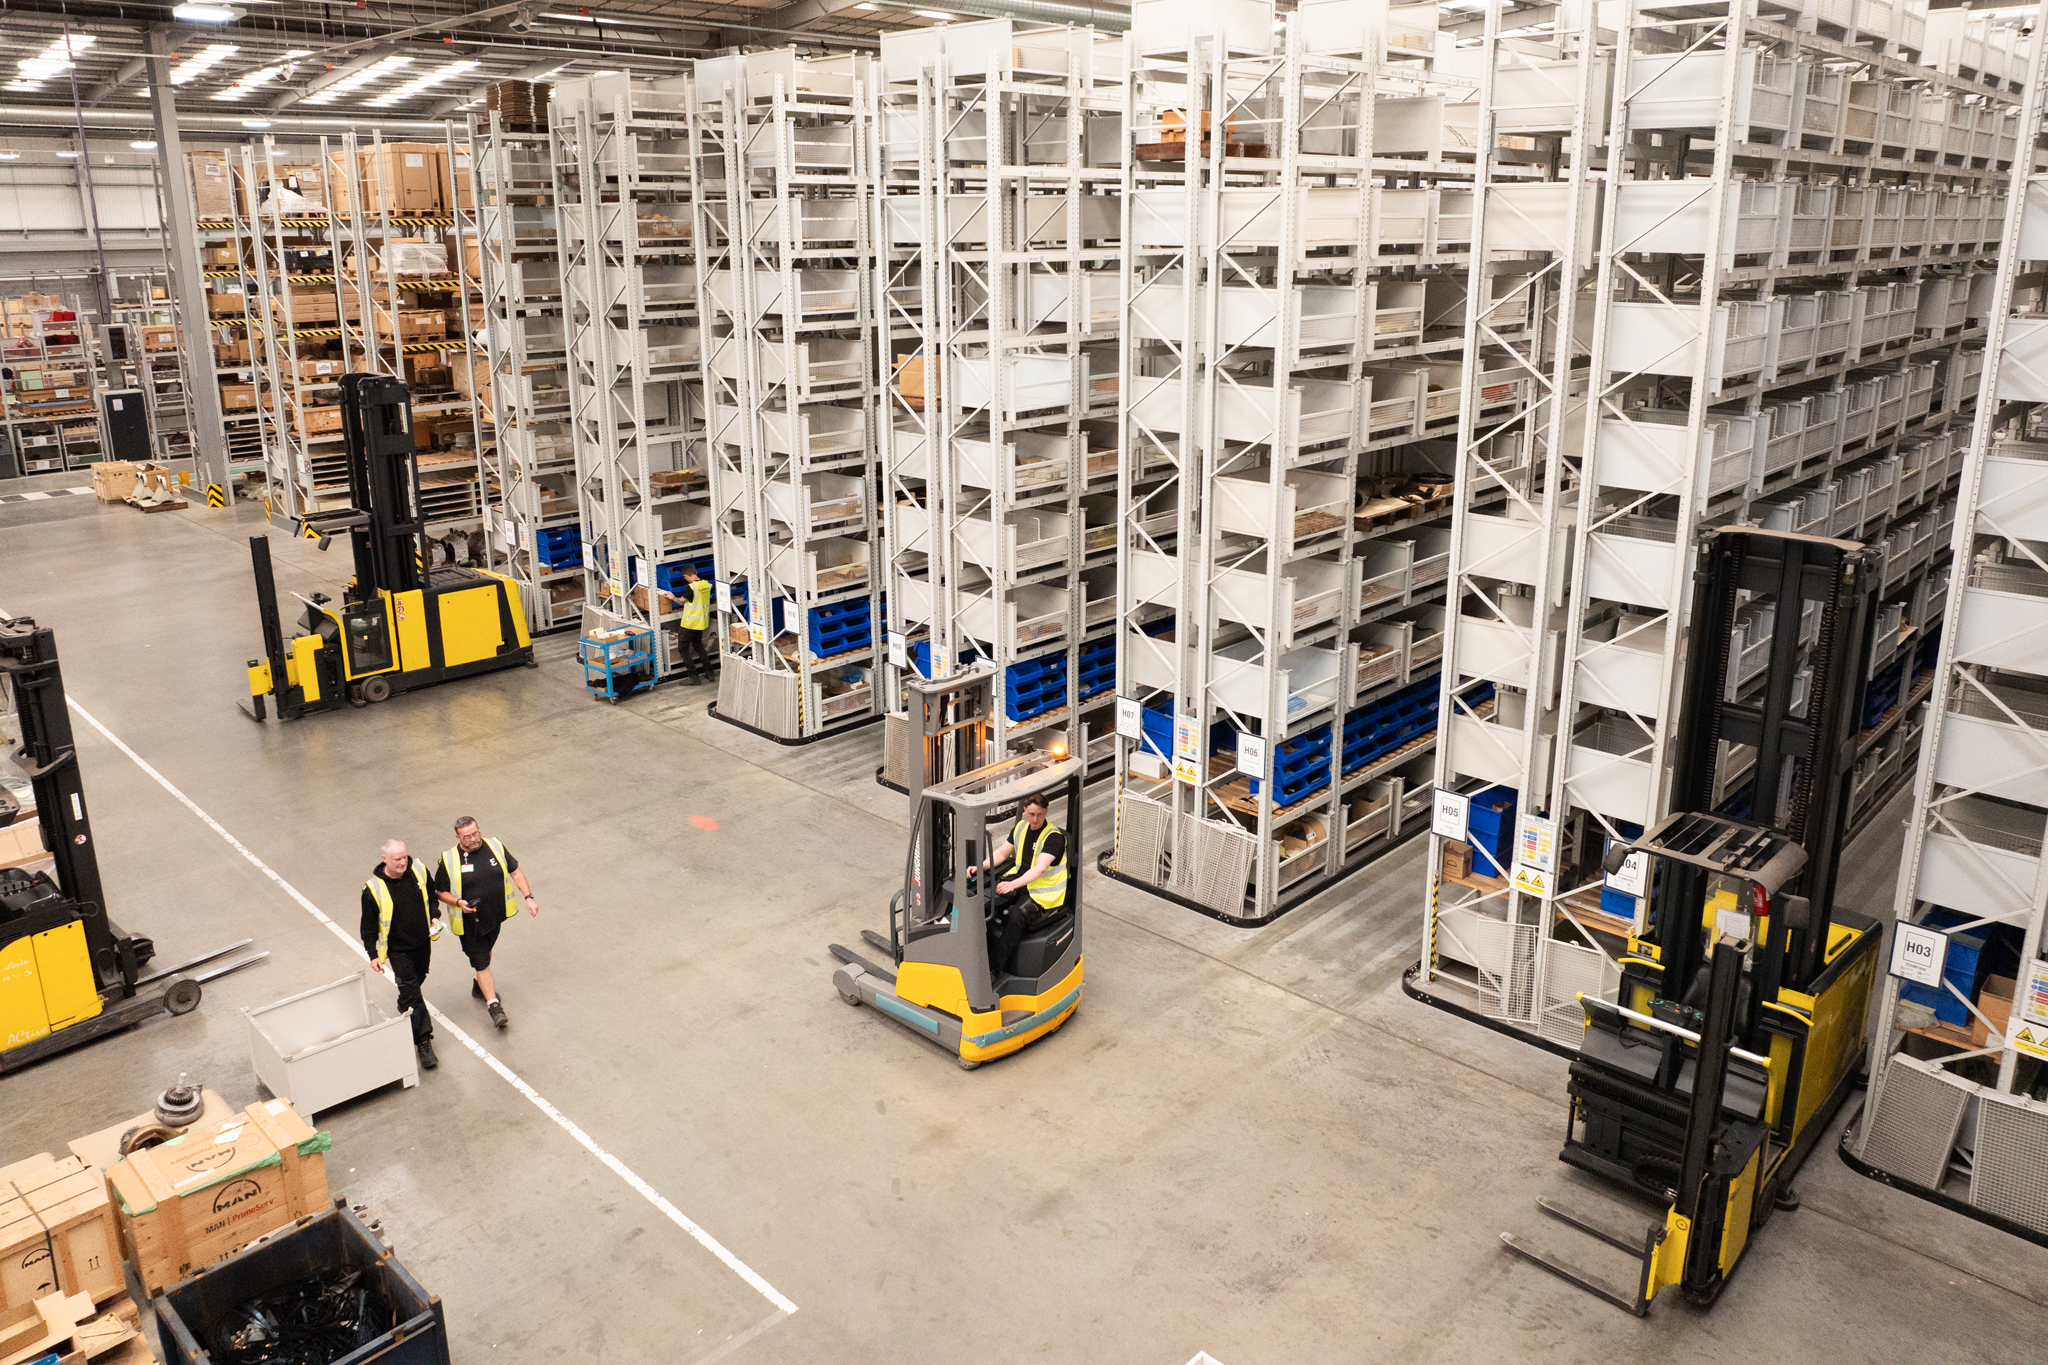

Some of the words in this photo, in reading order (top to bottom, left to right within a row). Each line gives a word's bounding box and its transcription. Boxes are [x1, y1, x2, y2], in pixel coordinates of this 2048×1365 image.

[1122, 709, 1135, 719] H07
[1244, 747, 1258, 757] H06
[1441, 804, 1459, 817] H05
[912, 831, 921, 886] JUNGHEIN
[1906, 941, 1931, 957] H03
[216, 1188, 258, 1212] MAN
[205, 1219, 226, 1235] MAN
[232, 1198, 275, 1222] PrimeServ
